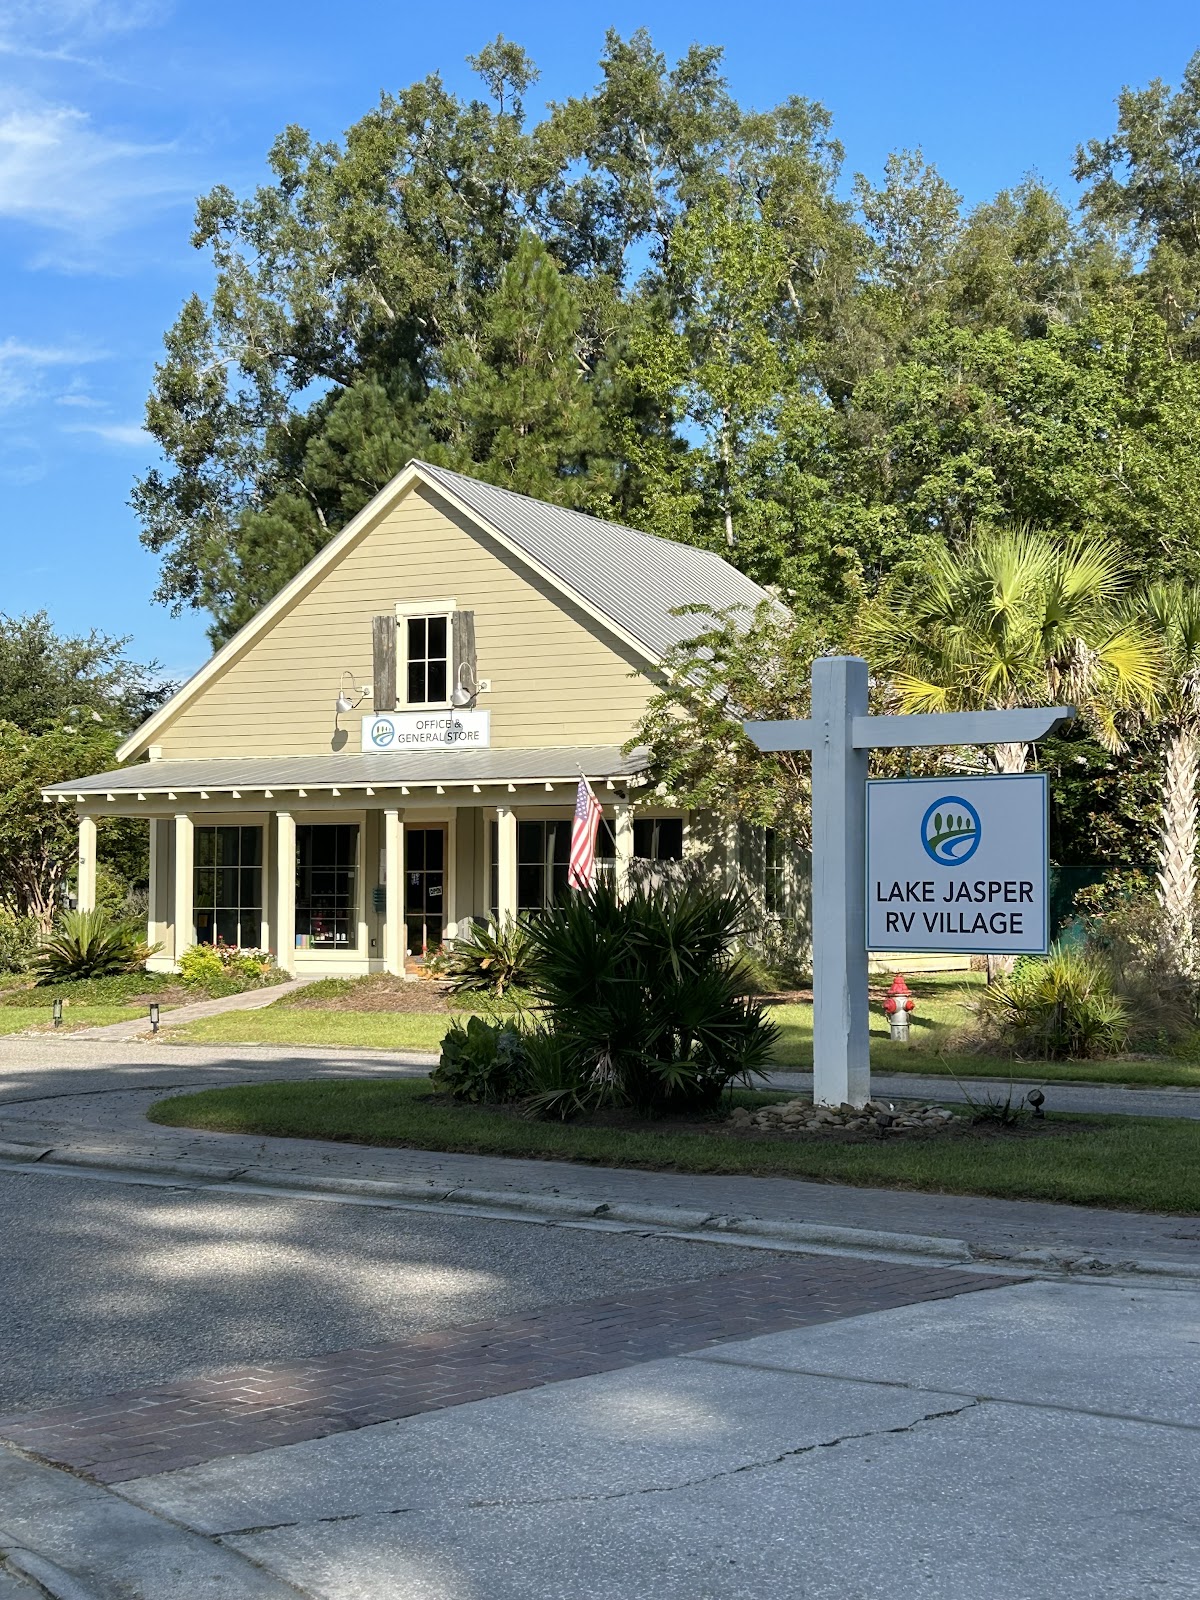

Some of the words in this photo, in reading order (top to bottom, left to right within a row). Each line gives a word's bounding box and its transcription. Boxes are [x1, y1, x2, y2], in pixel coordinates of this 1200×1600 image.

[416, 719, 451, 730] OFFICE
[454, 719, 463, 729] &
[398, 733, 444, 743] GENERAL
[447, 731, 479, 741] STORE
[877, 881, 935, 902] LAKE
[943, 881, 1034, 903] JASPER
[886, 912, 915, 932] RV
[923, 912, 1023, 934] VILLAGE
